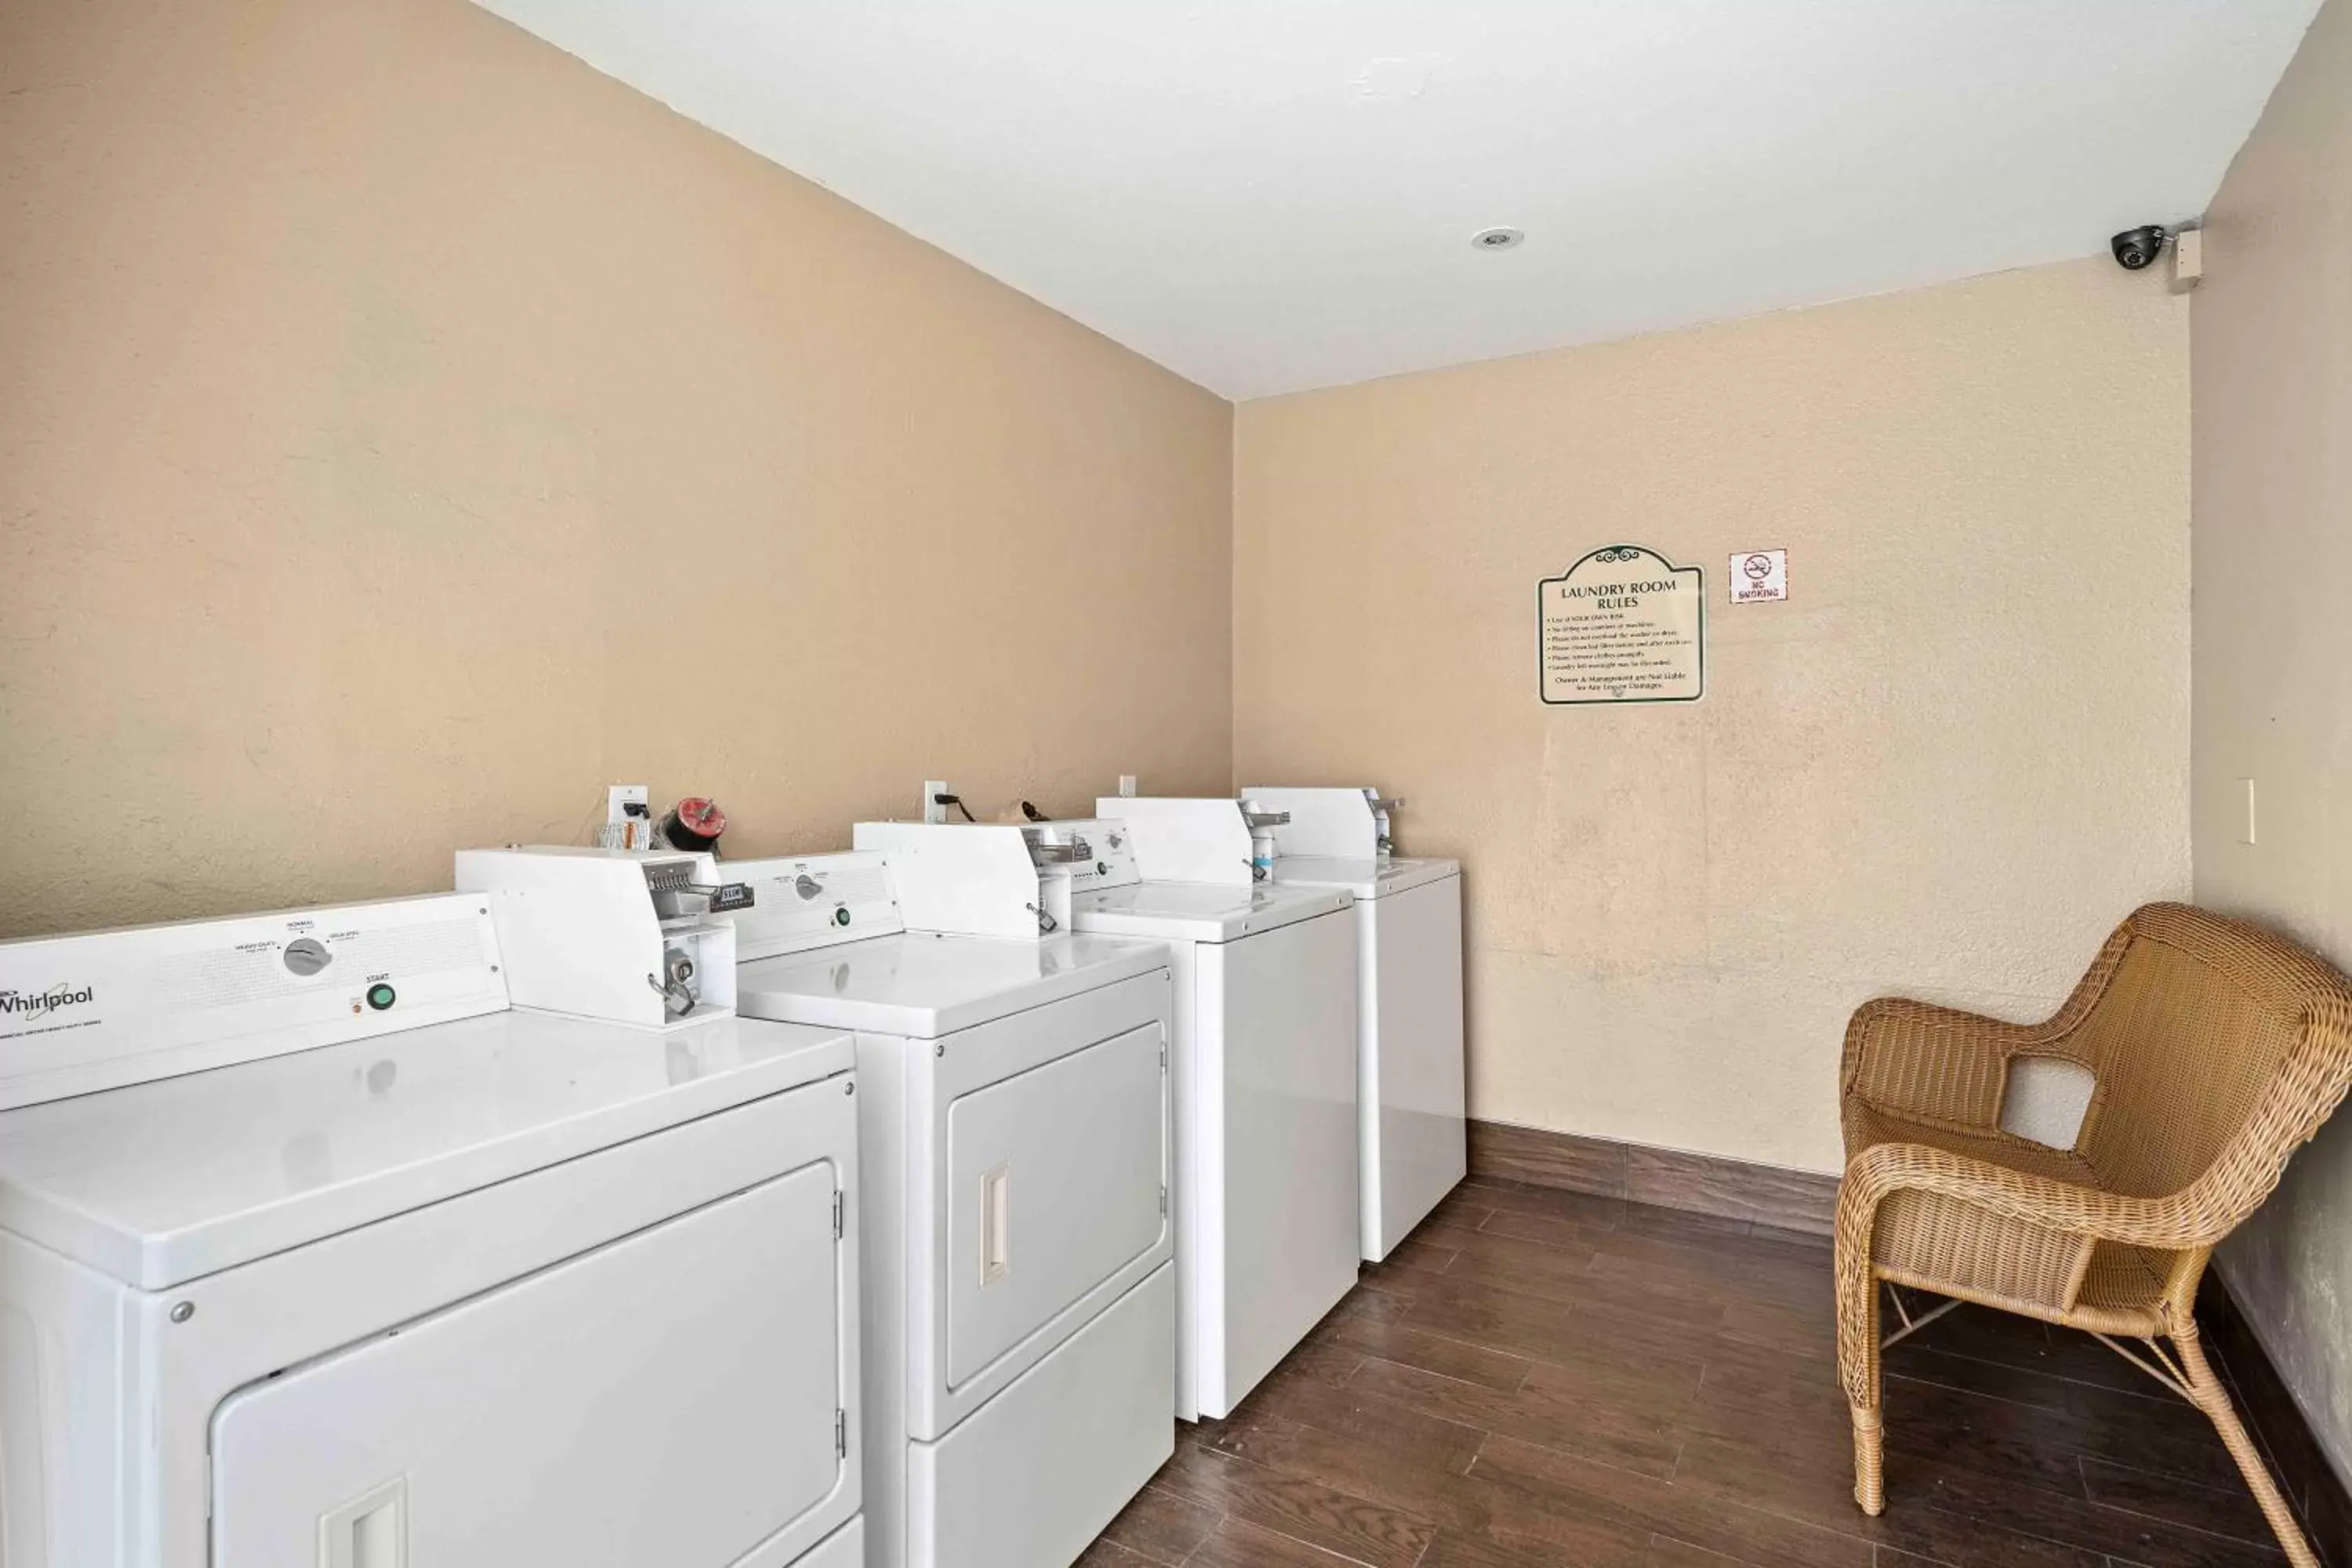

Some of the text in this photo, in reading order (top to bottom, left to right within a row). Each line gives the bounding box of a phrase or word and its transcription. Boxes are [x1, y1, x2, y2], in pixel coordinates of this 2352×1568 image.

[1562, 580, 1676, 598] LAUNDRY ROOM
[1739, 590, 1779, 599] SMOKING
[1597, 597, 1638, 609] RULES
[1589, 675, 1633, 684] Management
[366, 972, 389, 984] START
[0, 986, 93, 1013] Whirlpool
